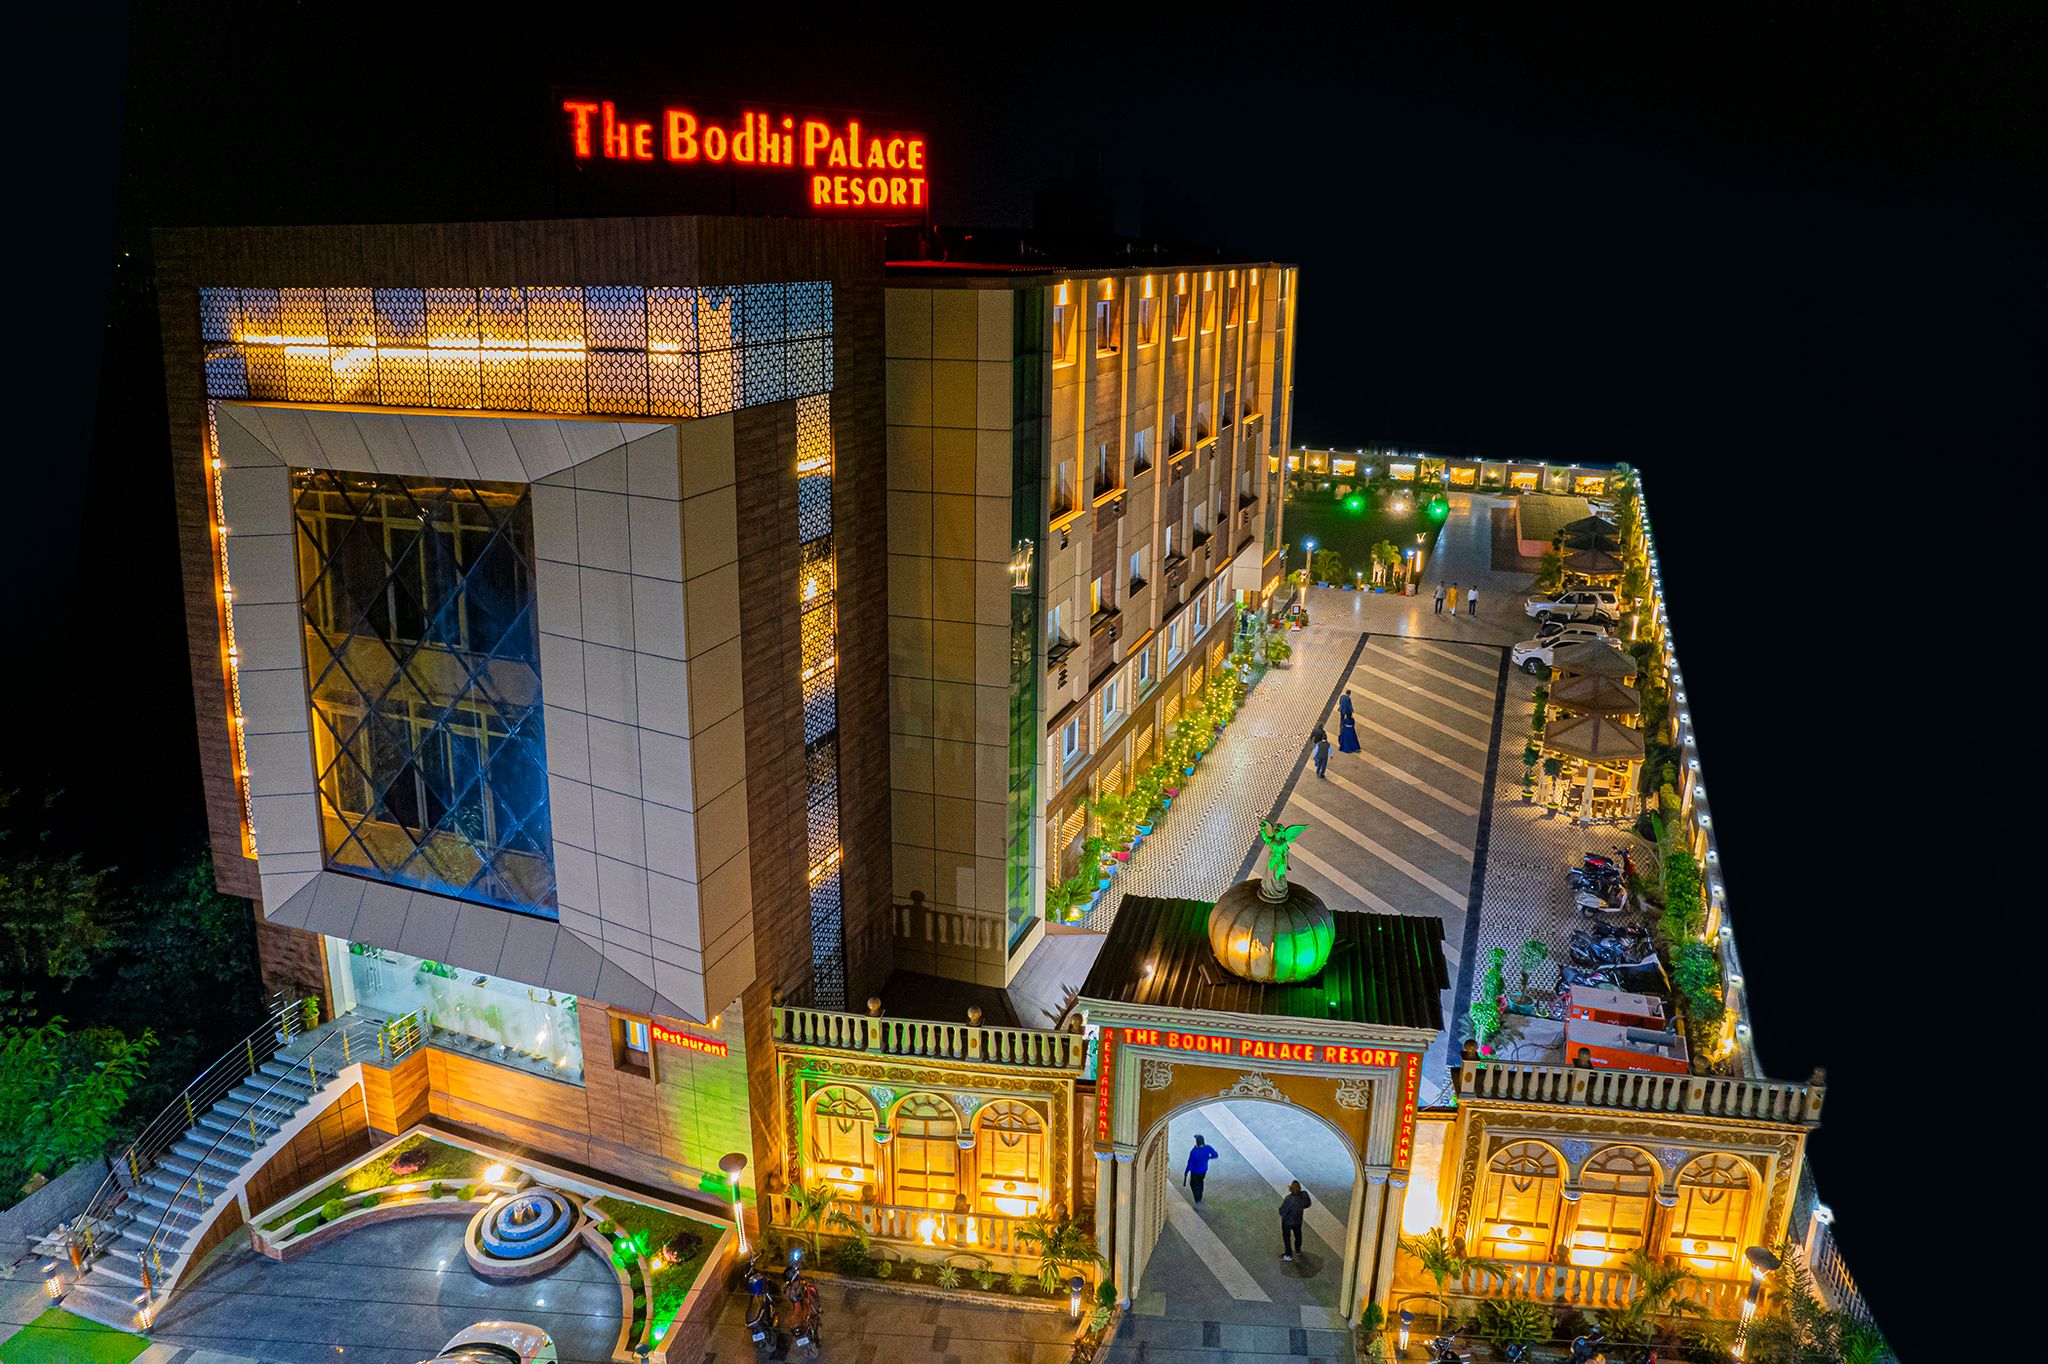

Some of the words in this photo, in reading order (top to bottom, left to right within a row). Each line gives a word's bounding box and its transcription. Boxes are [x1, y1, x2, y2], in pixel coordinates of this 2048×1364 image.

[812, 175, 925, 205] RESORT
[652, 1026, 727, 1057] Restaurant
[1124, 1028, 1159, 1046] THE
[1167, 1031, 1231, 1054] BODHI
[1239, 1039, 1314, 1062] PALACE
[1324, 1046, 1398, 1067] RESORT
[1099, 1028, 1114, 1140] RESTAURANT
[1399, 1056, 1418, 1168] RESTAURANT
